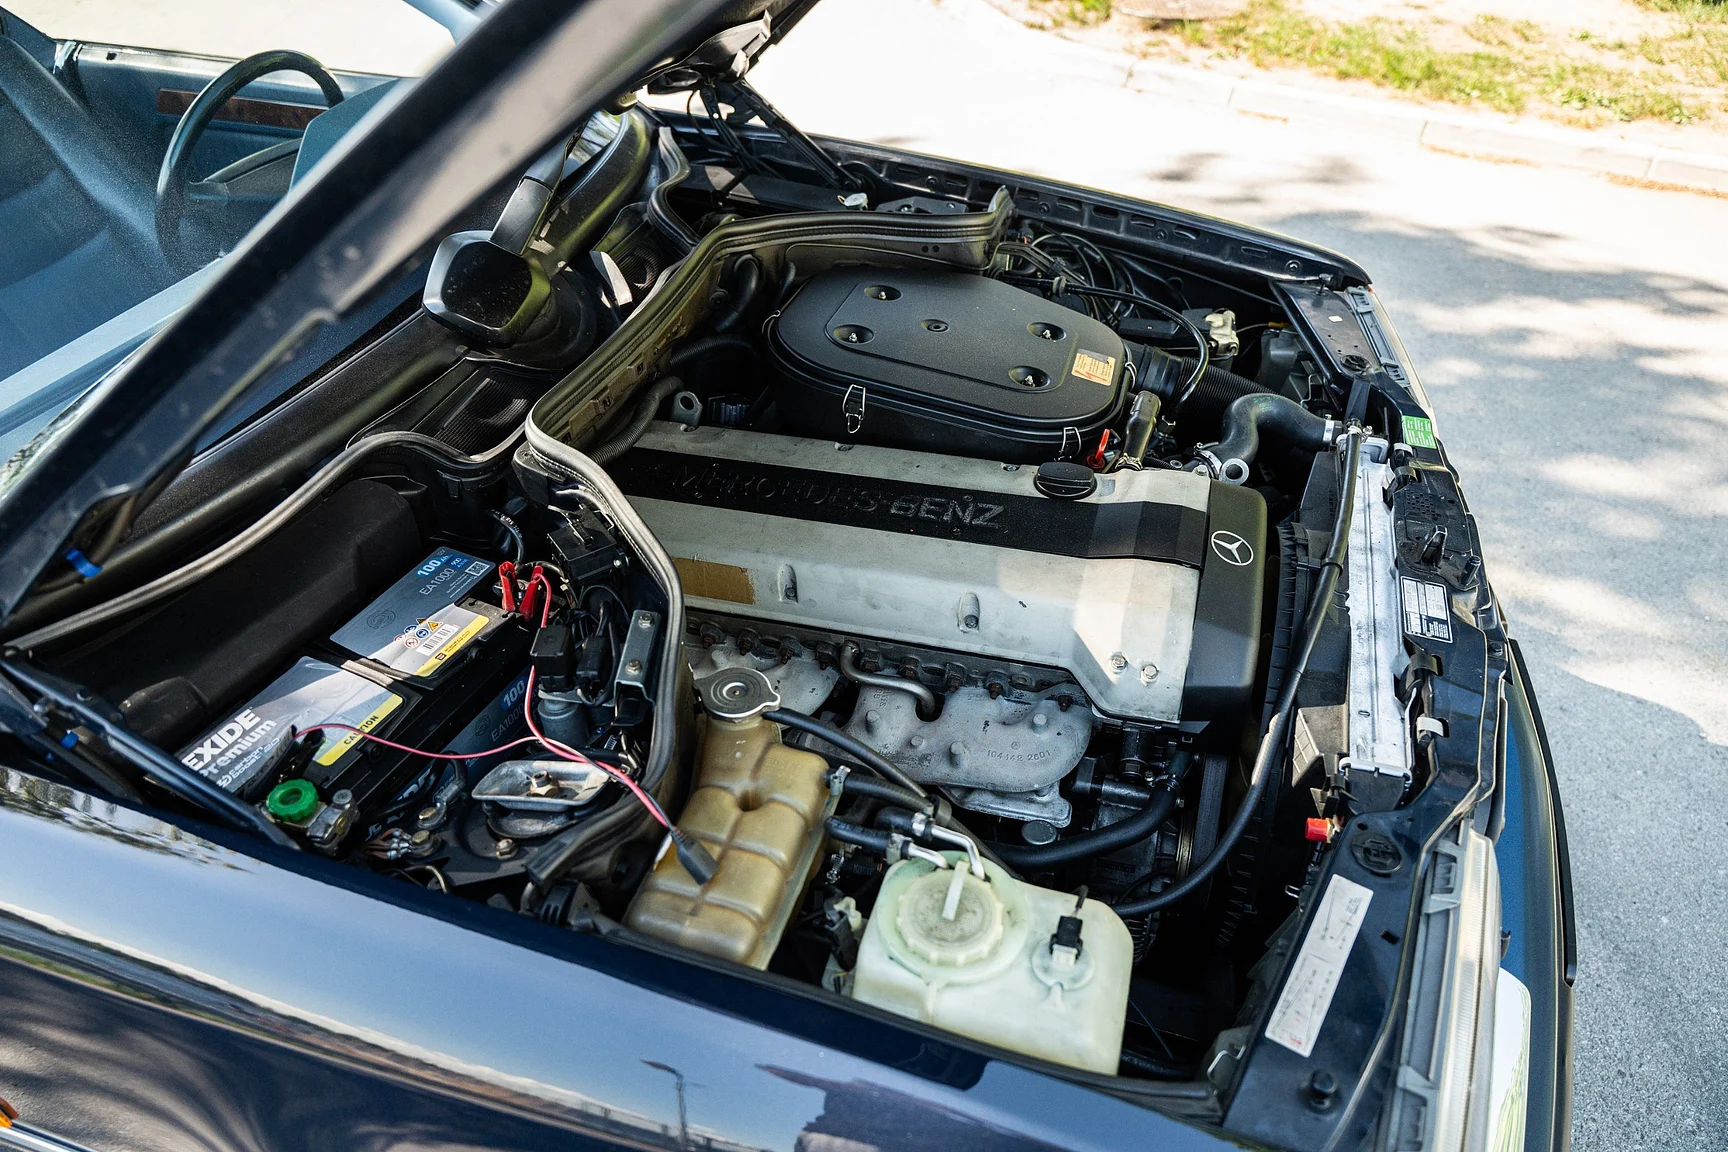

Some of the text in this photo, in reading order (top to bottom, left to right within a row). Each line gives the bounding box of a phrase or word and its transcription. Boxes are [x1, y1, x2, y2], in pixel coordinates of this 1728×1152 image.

[417, 559, 442, 576] 100
[419, 568, 455, 595] EA1000
[503, 680, 526, 707] 100
[181, 708, 261, 772] EXIDE
